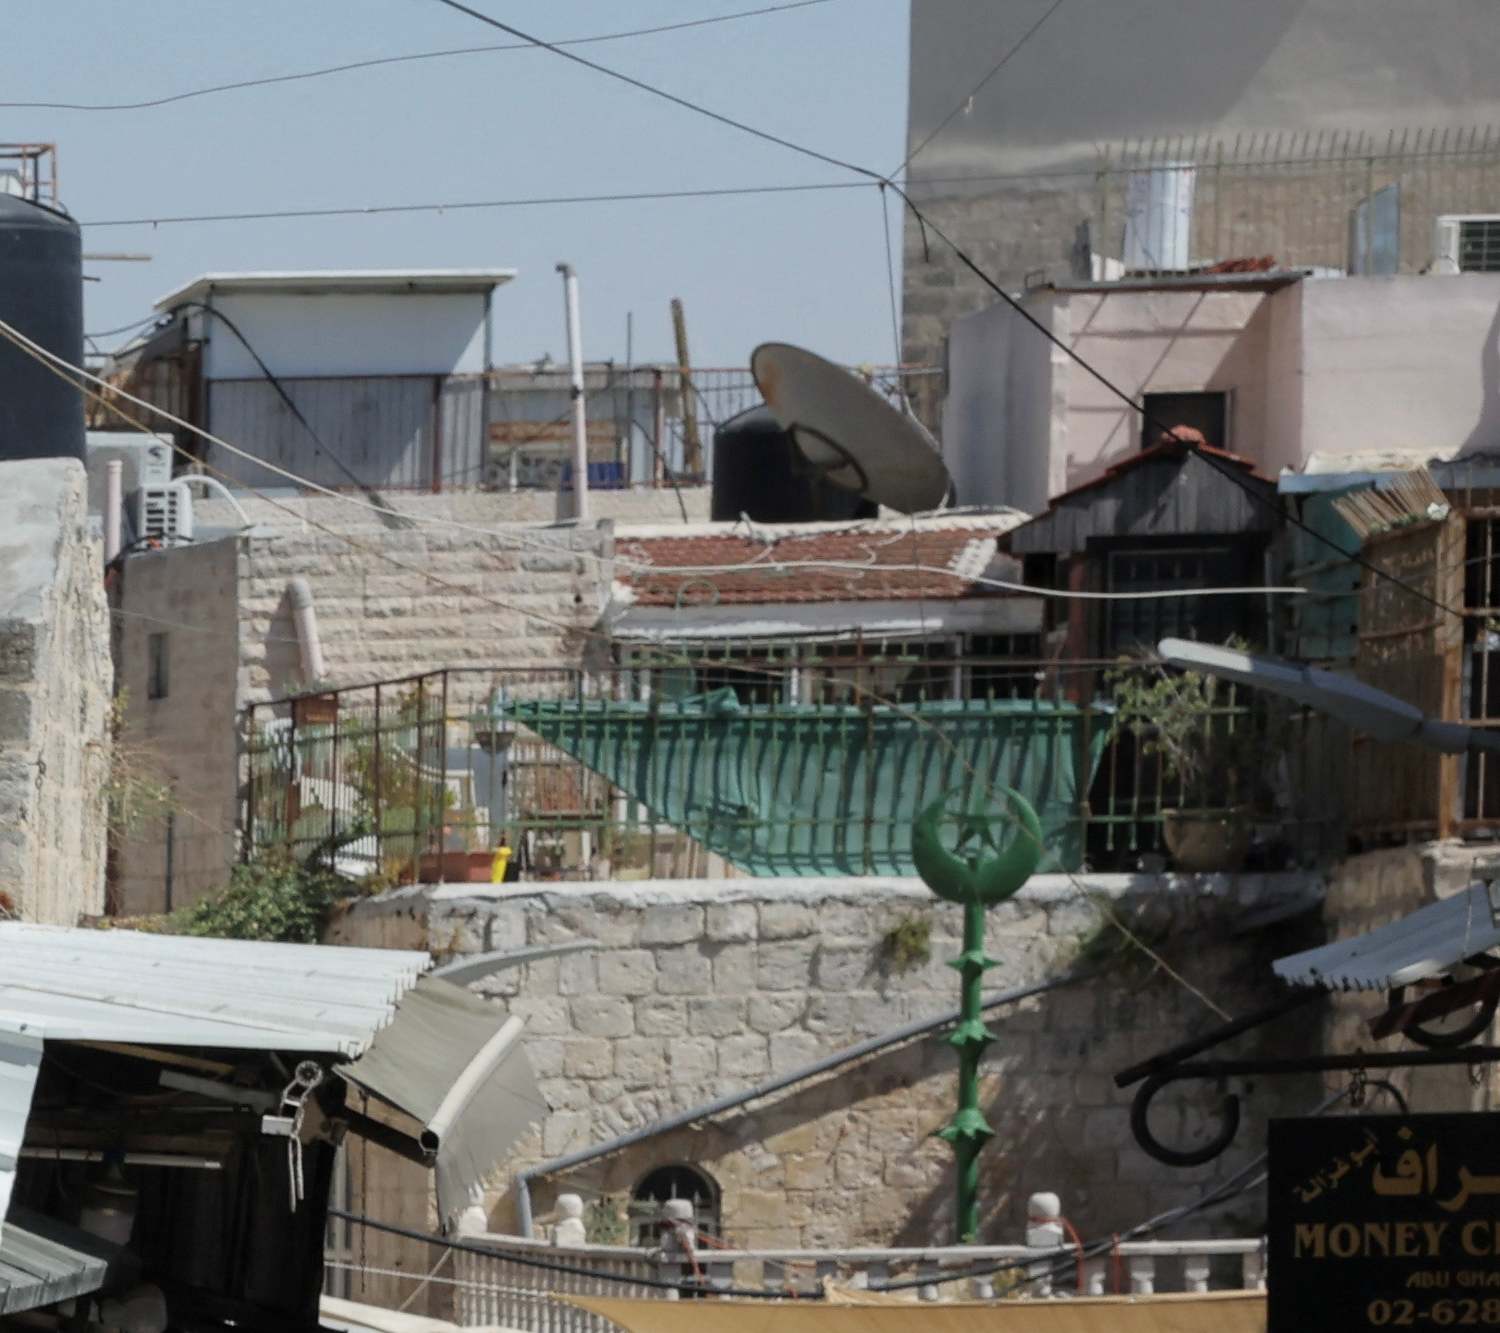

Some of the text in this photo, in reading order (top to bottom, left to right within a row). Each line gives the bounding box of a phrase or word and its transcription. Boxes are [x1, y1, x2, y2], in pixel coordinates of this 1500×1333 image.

[1293, 1221, 1450, 1259] MONEY
[1405, 1270, 1451, 1289] ABU
[1366, 1298, 1500, 1326] 02-628
